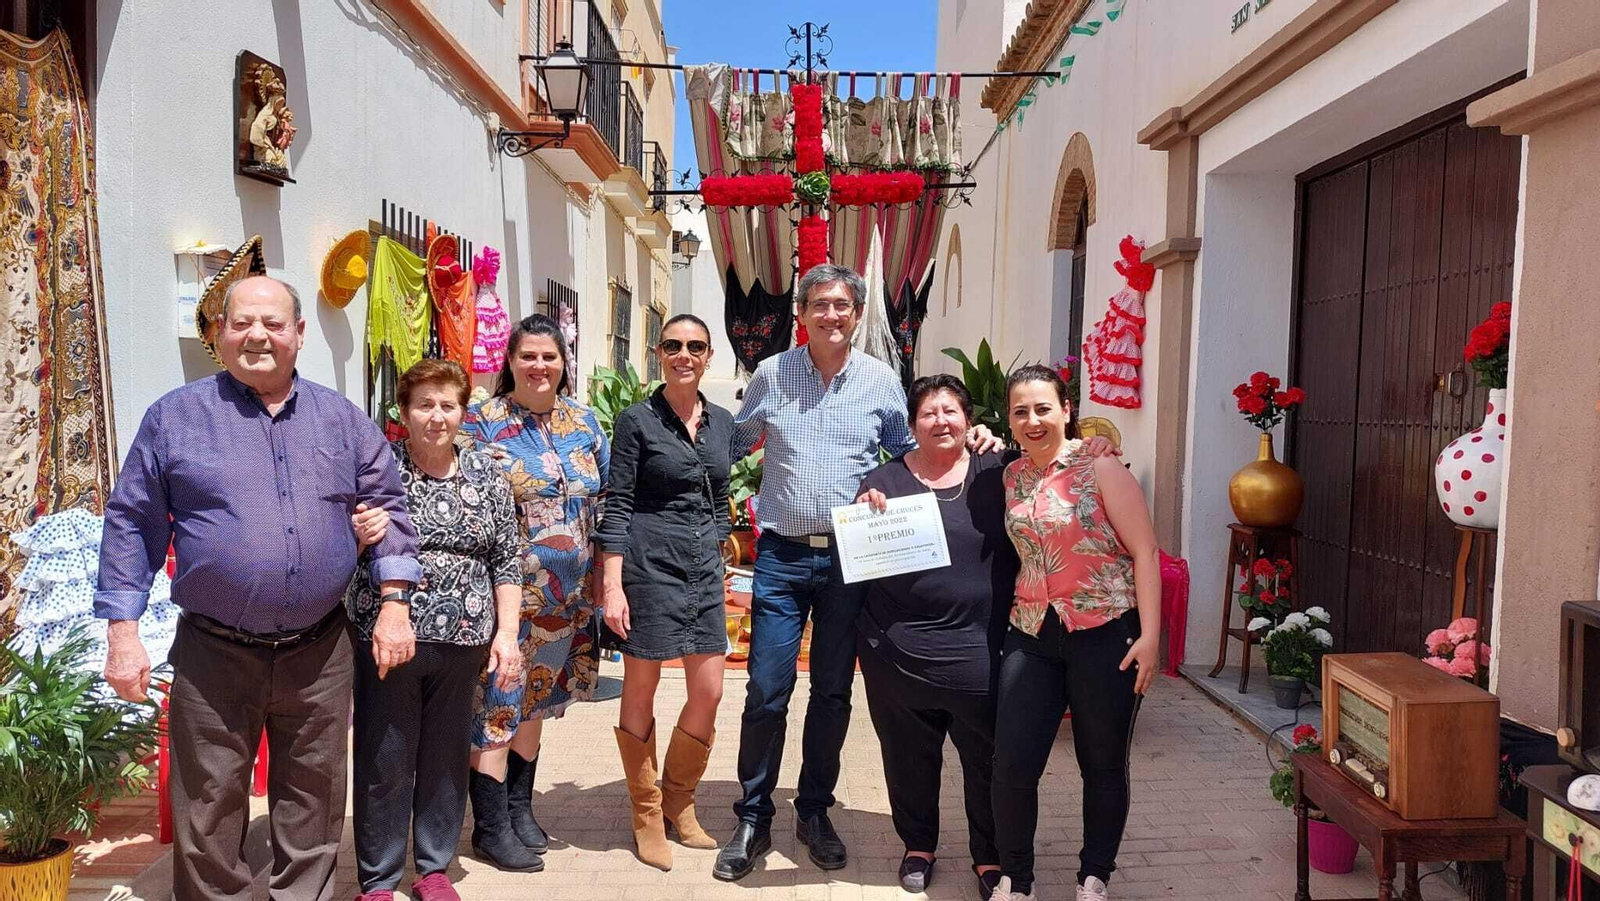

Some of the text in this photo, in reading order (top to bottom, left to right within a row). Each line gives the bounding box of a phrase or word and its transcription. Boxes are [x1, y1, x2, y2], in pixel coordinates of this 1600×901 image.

[1231, 2, 1250, 34] SAN
[886, 508, 896, 516] DE
[897, 505, 923, 515] CRUCES
[868, 516, 908, 529] MAYO 2022
